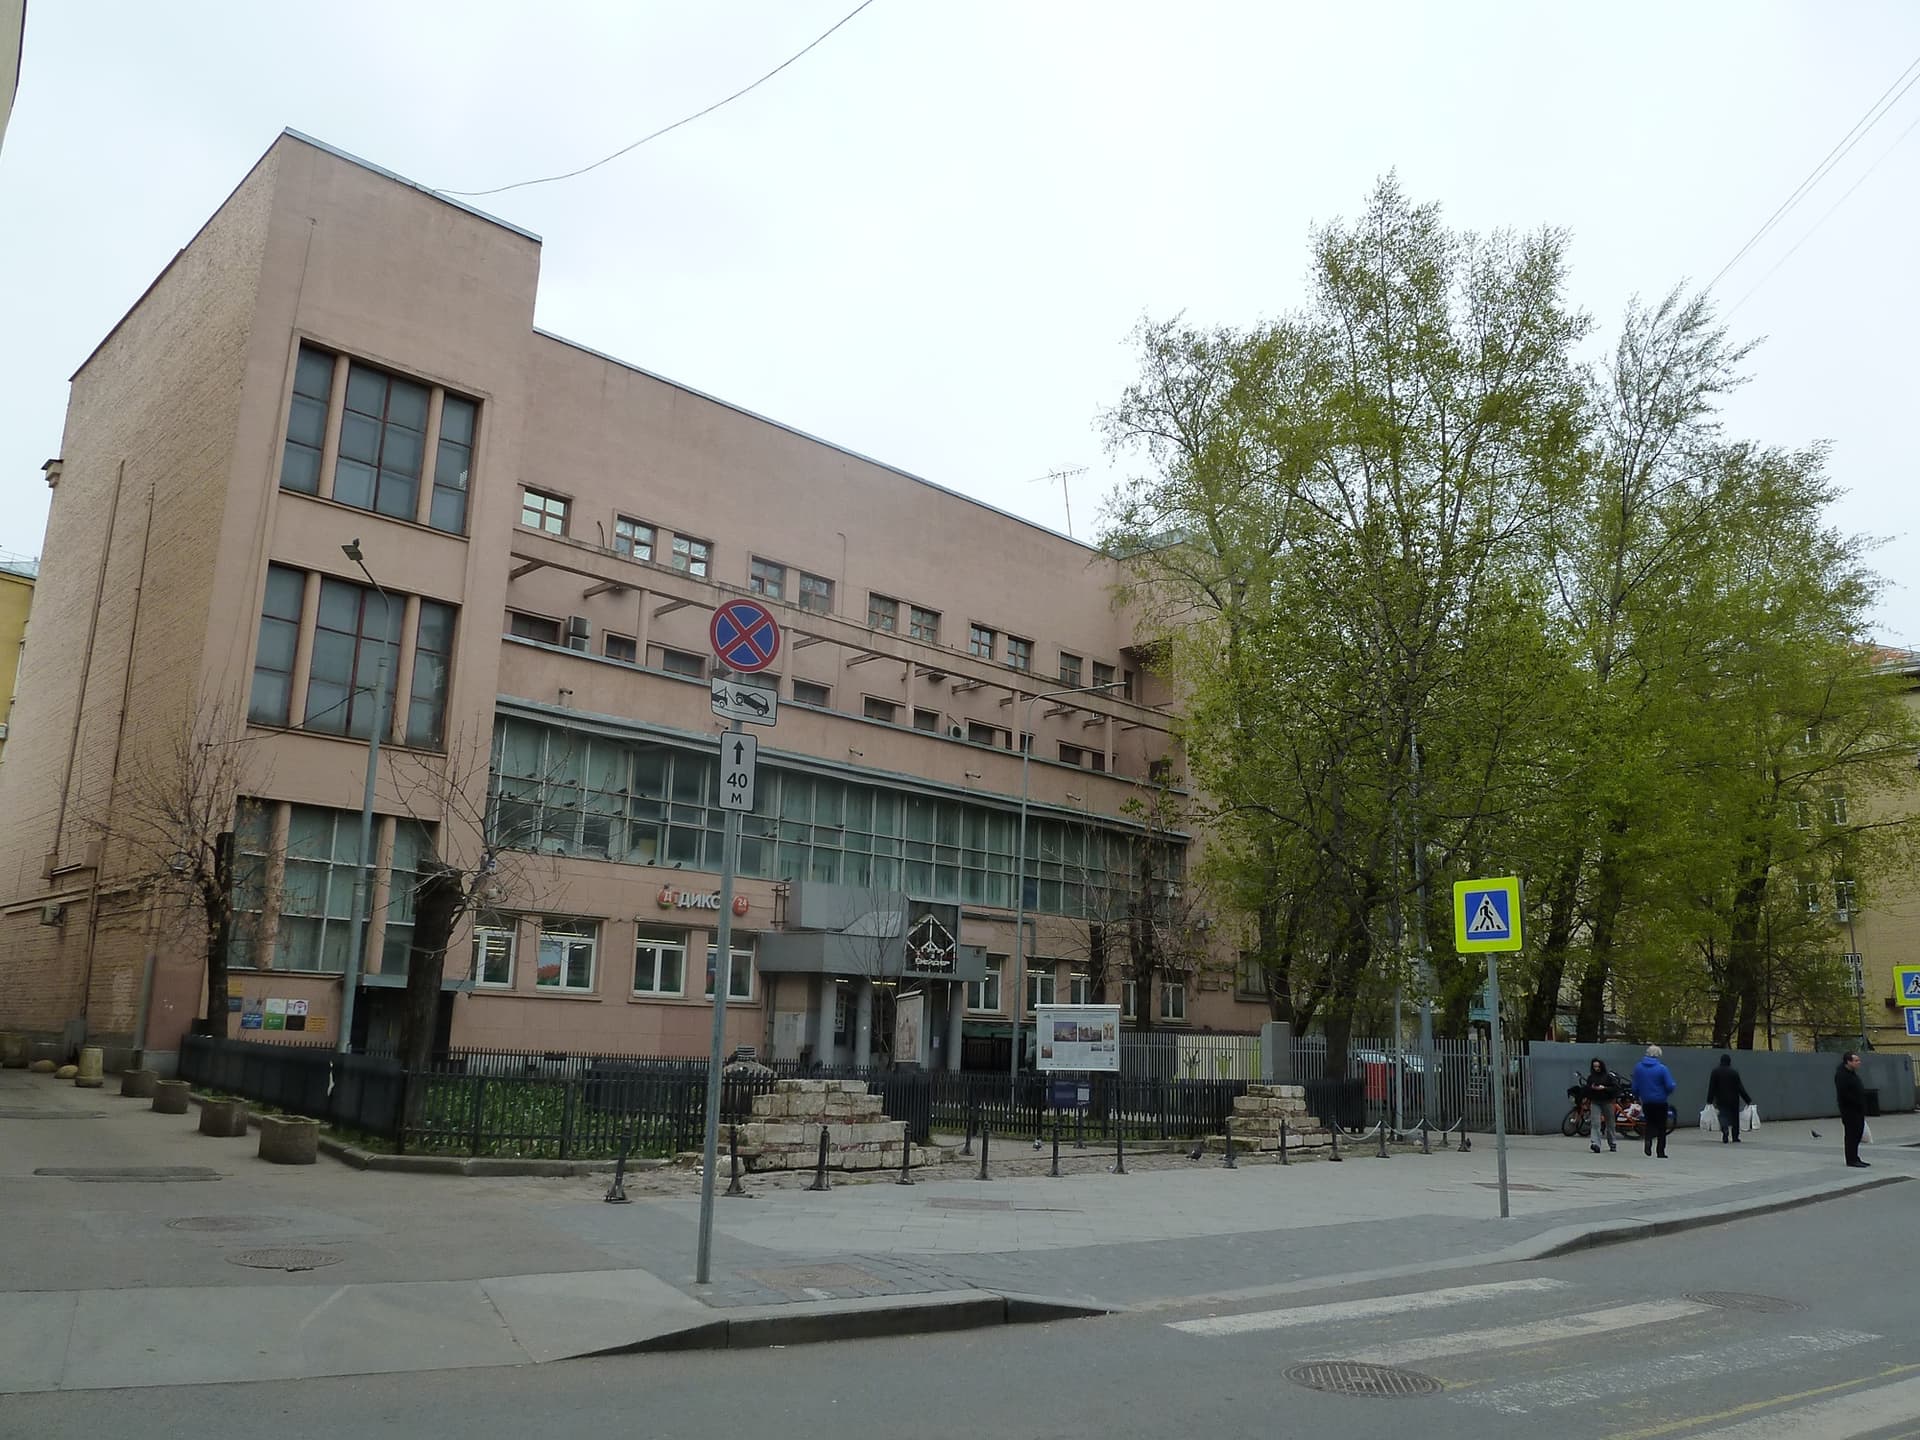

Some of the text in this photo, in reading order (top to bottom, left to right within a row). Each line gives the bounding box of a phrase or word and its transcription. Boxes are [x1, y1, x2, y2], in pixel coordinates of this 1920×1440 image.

[727, 772, 748, 788] 40
[731, 793, 742, 804] М
[677, 891, 721, 910] ДИКС
